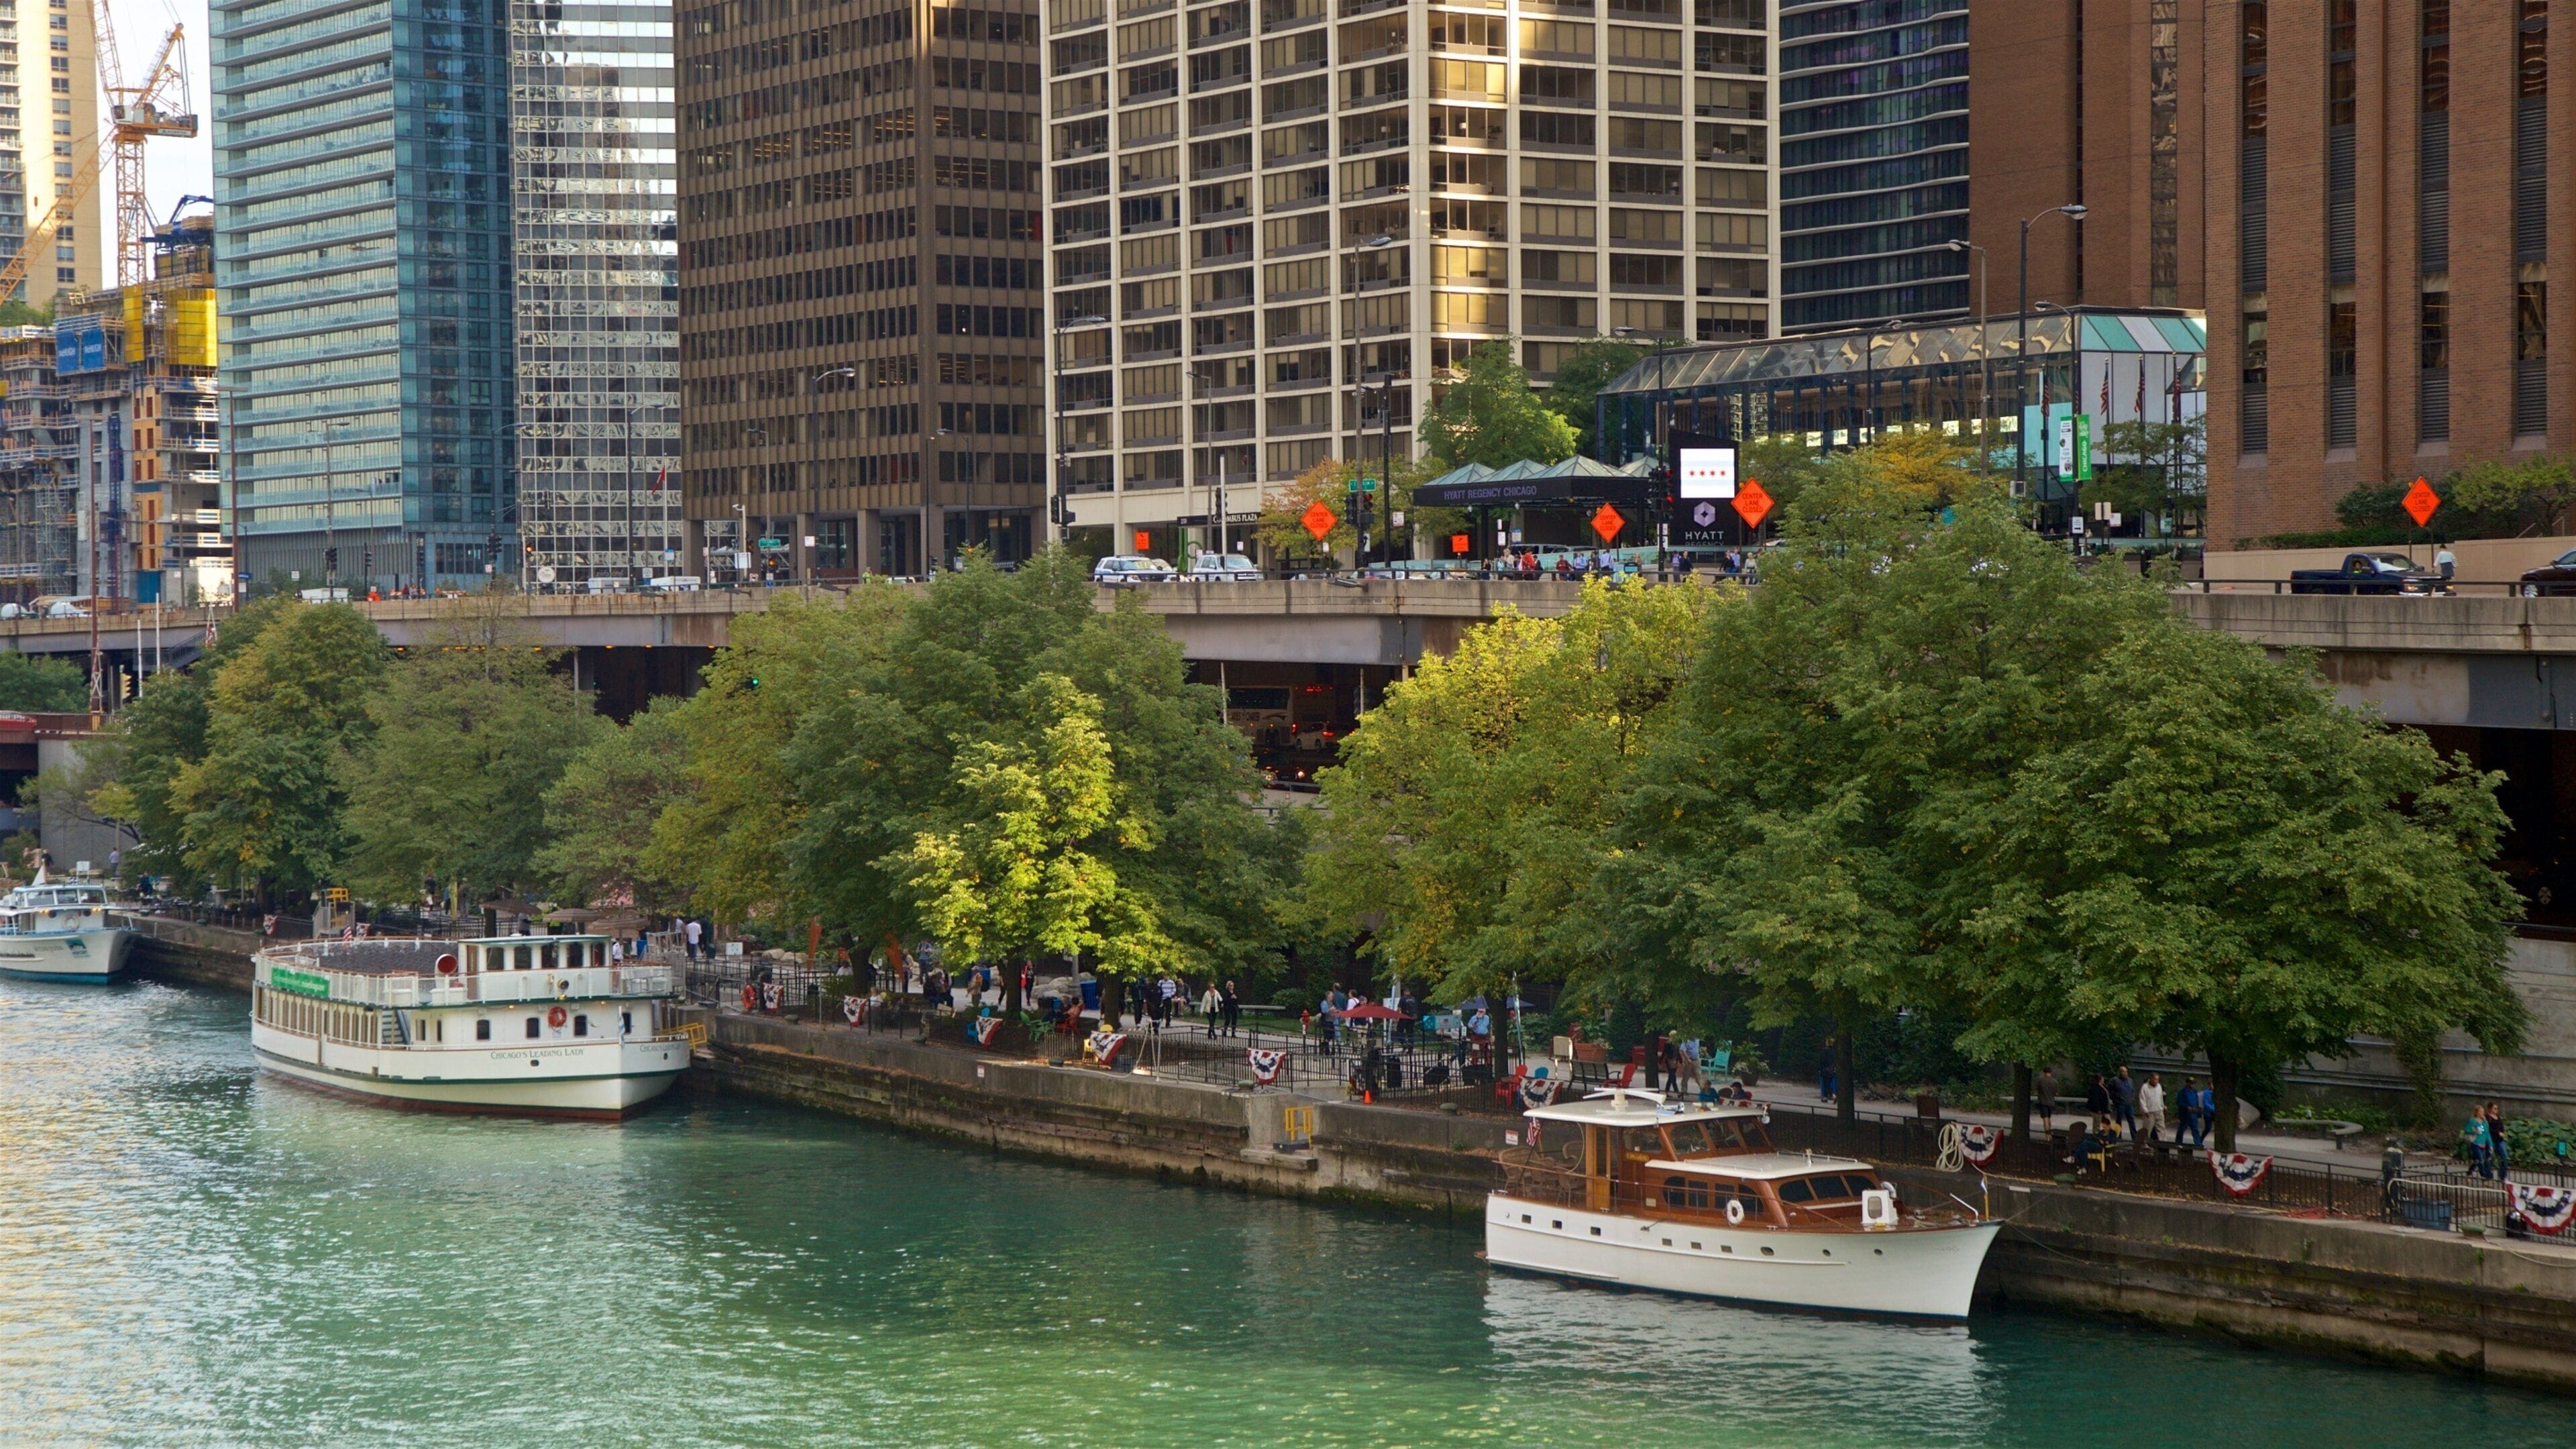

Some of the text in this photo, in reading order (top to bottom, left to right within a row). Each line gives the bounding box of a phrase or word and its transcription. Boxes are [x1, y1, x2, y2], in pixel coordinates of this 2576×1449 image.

[1444, 486, 1536, 500] HYATT REGENCY CHICAGO
[1242, 513, 1257, 521] PLAZA
[1685, 531, 1724, 540] HYATT
[491, 1048, 585, 1059] CHICAGO'S LEADING LADY
